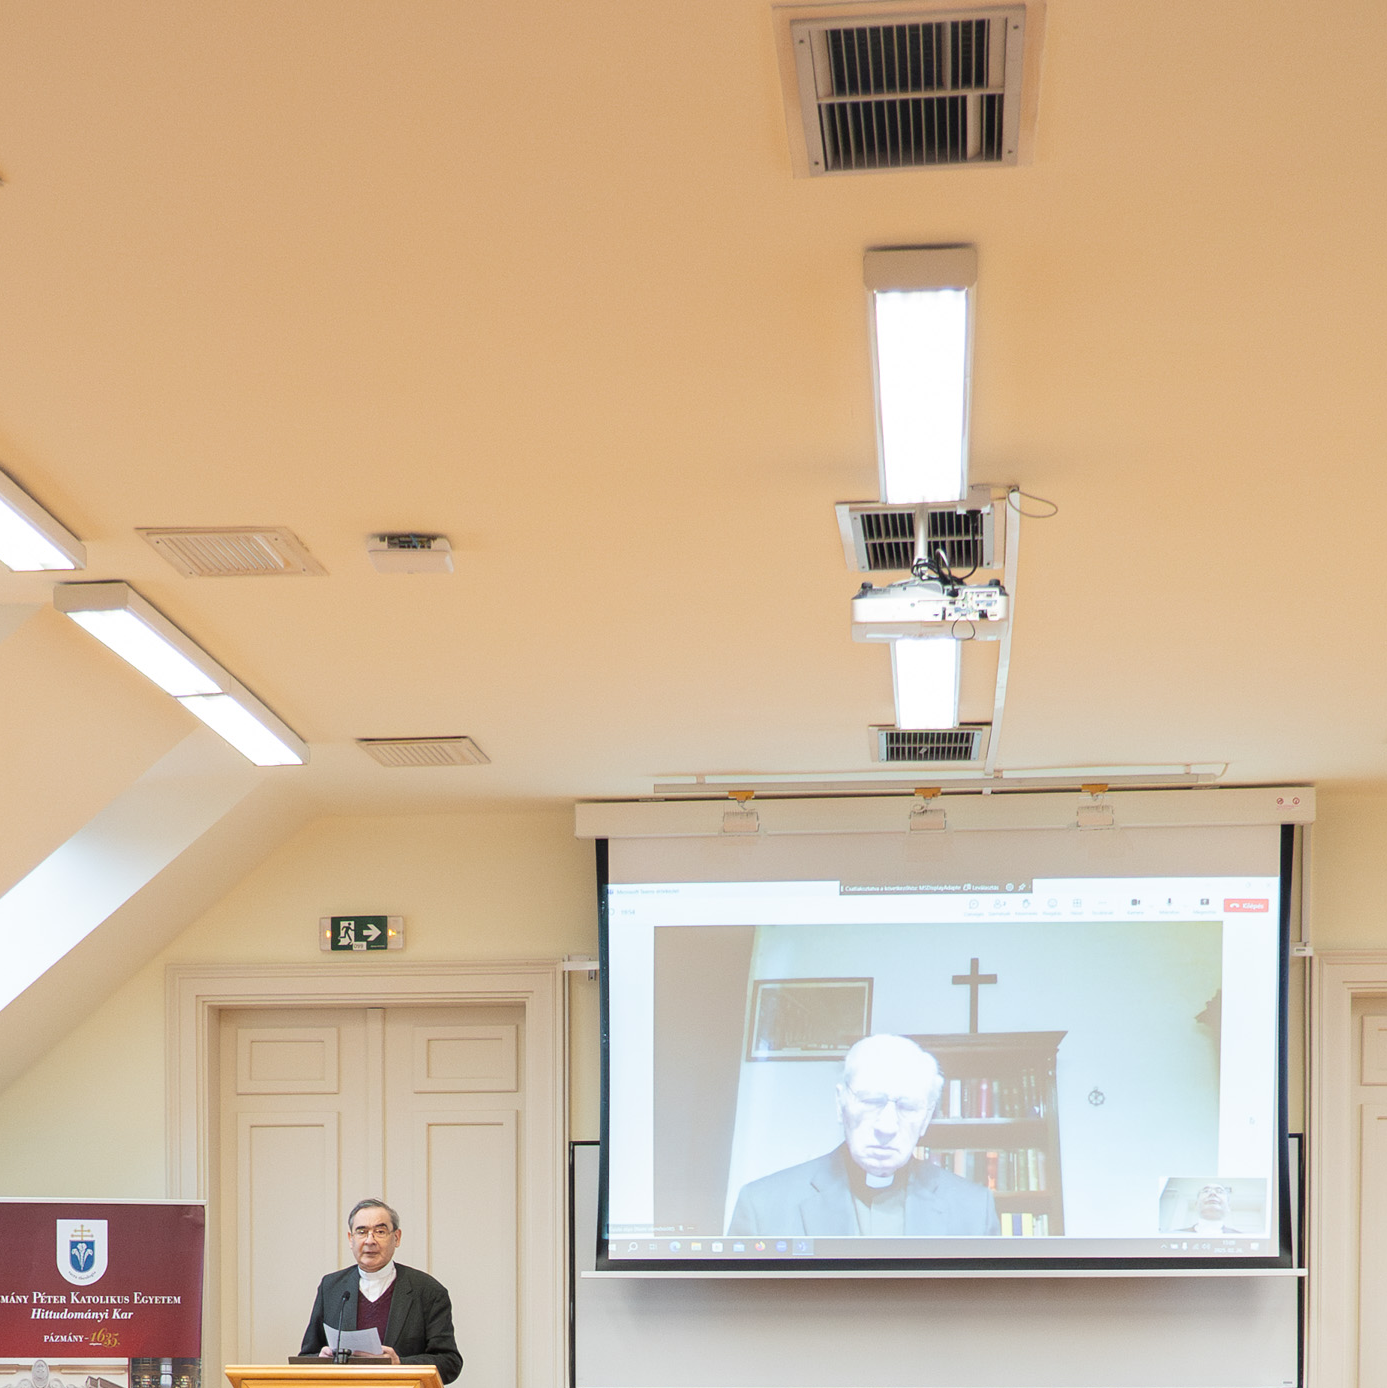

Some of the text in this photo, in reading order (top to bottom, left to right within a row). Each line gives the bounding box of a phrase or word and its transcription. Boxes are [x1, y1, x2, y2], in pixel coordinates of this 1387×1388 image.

[1241, 901, 1265, 910] Kilépés
[30, 1307, 135, 1323] Hittudományi Kar
